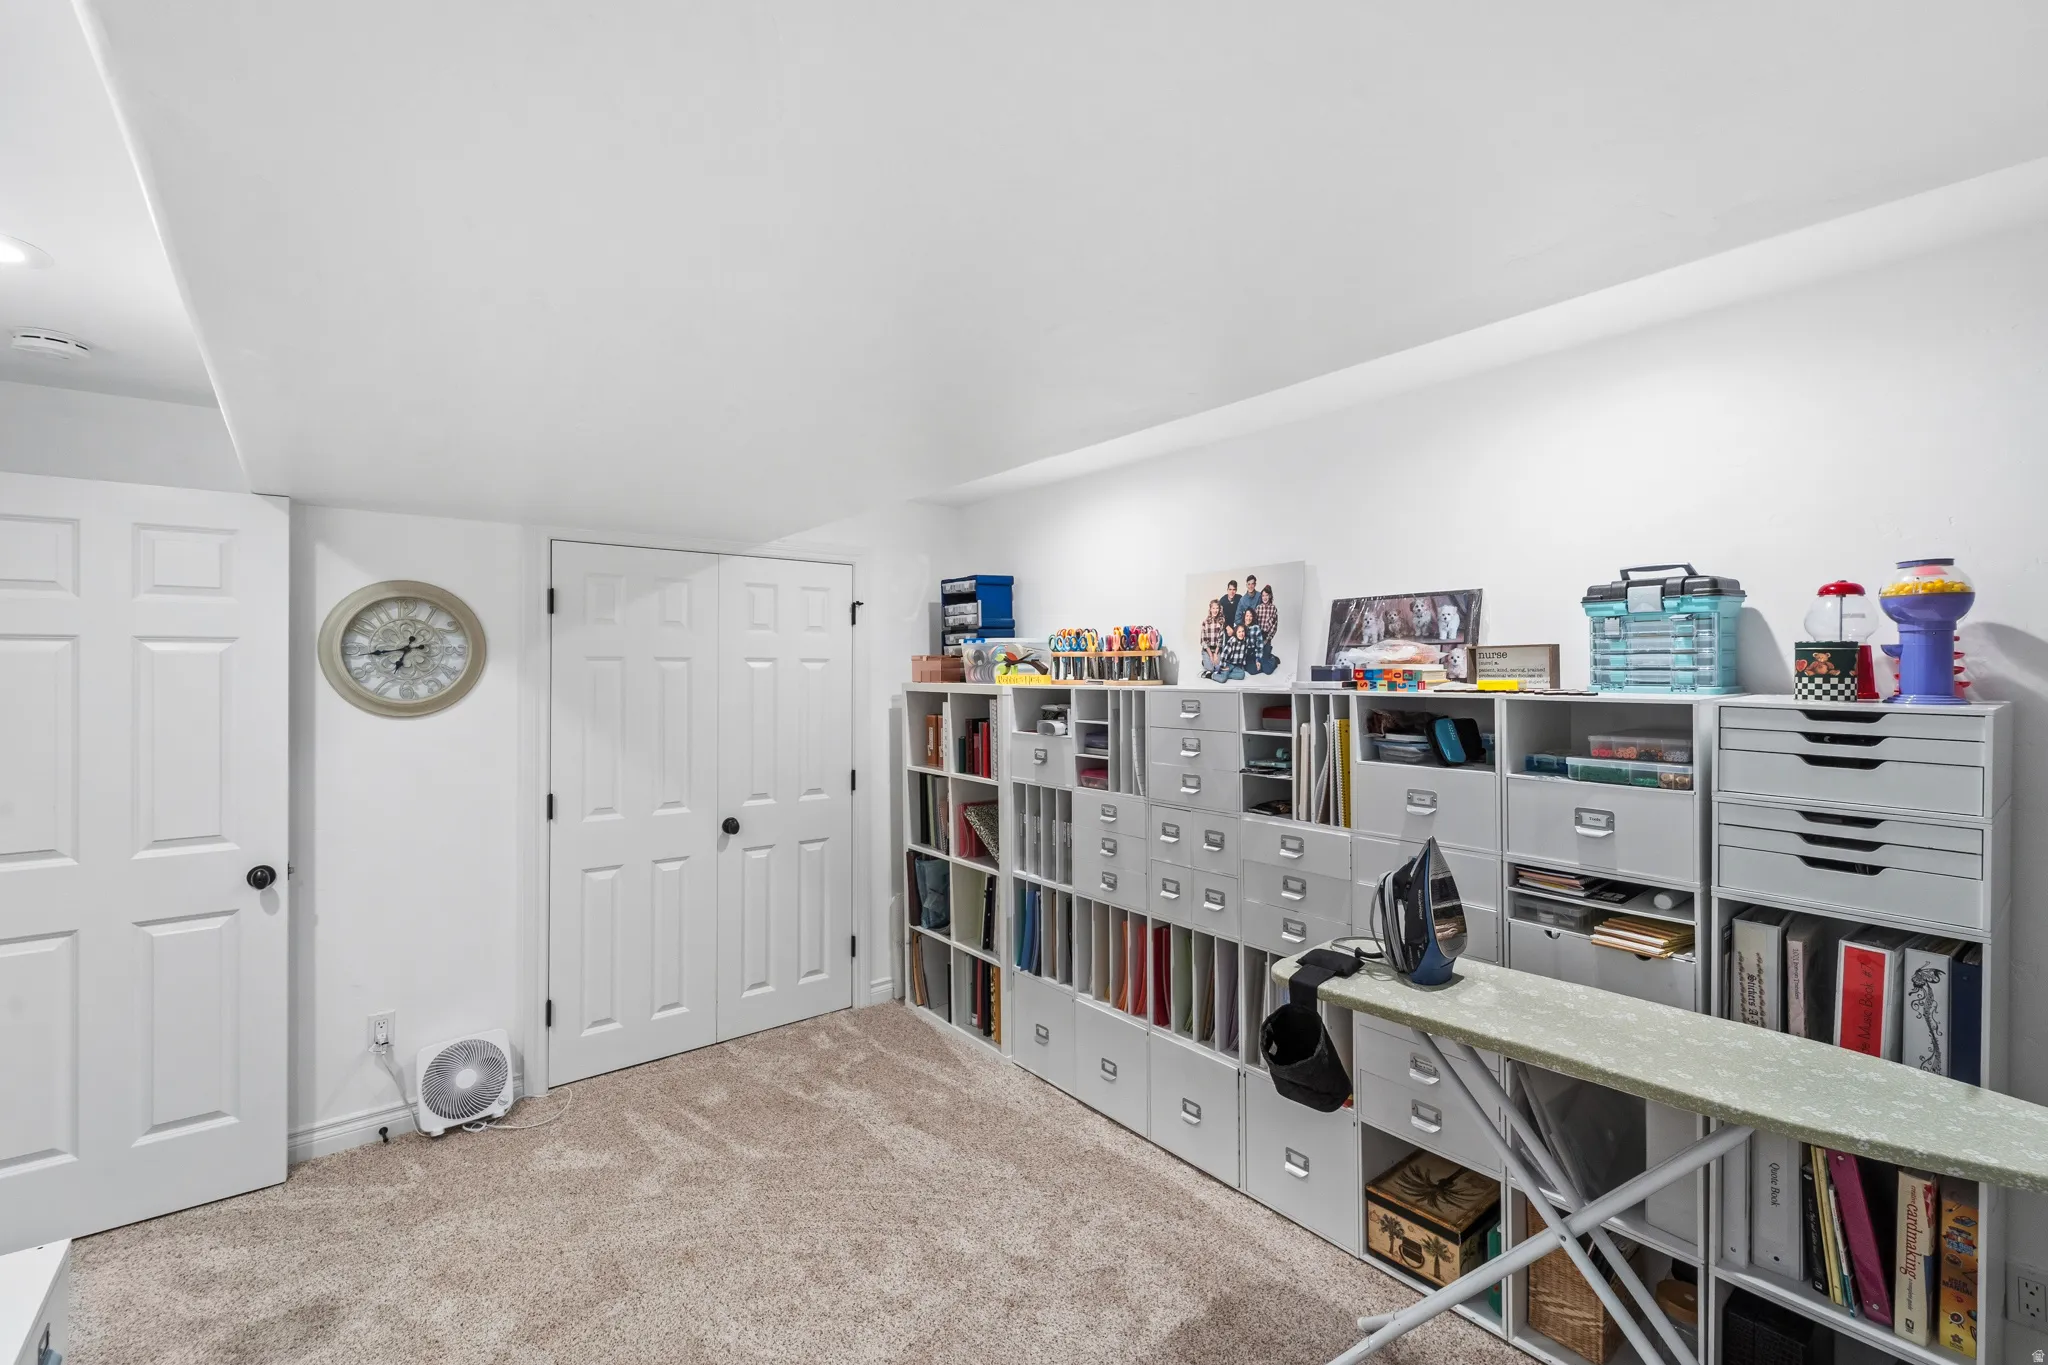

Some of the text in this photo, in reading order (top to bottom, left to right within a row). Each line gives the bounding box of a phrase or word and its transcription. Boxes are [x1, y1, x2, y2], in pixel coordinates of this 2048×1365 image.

[395, 599, 418, 620] 12
[1478, 651, 1508, 659] nurse
[1860, 961, 1873, 978] #7
[1747, 973, 1757, 1008] Stickers
[1859, 983, 1874, 1008] Book
[1858, 1009, 1873, 1040] Music
[1769, 1162, 1780, 1207] Quote Book
[1899, 1203, 1923, 1280] cardmaking
